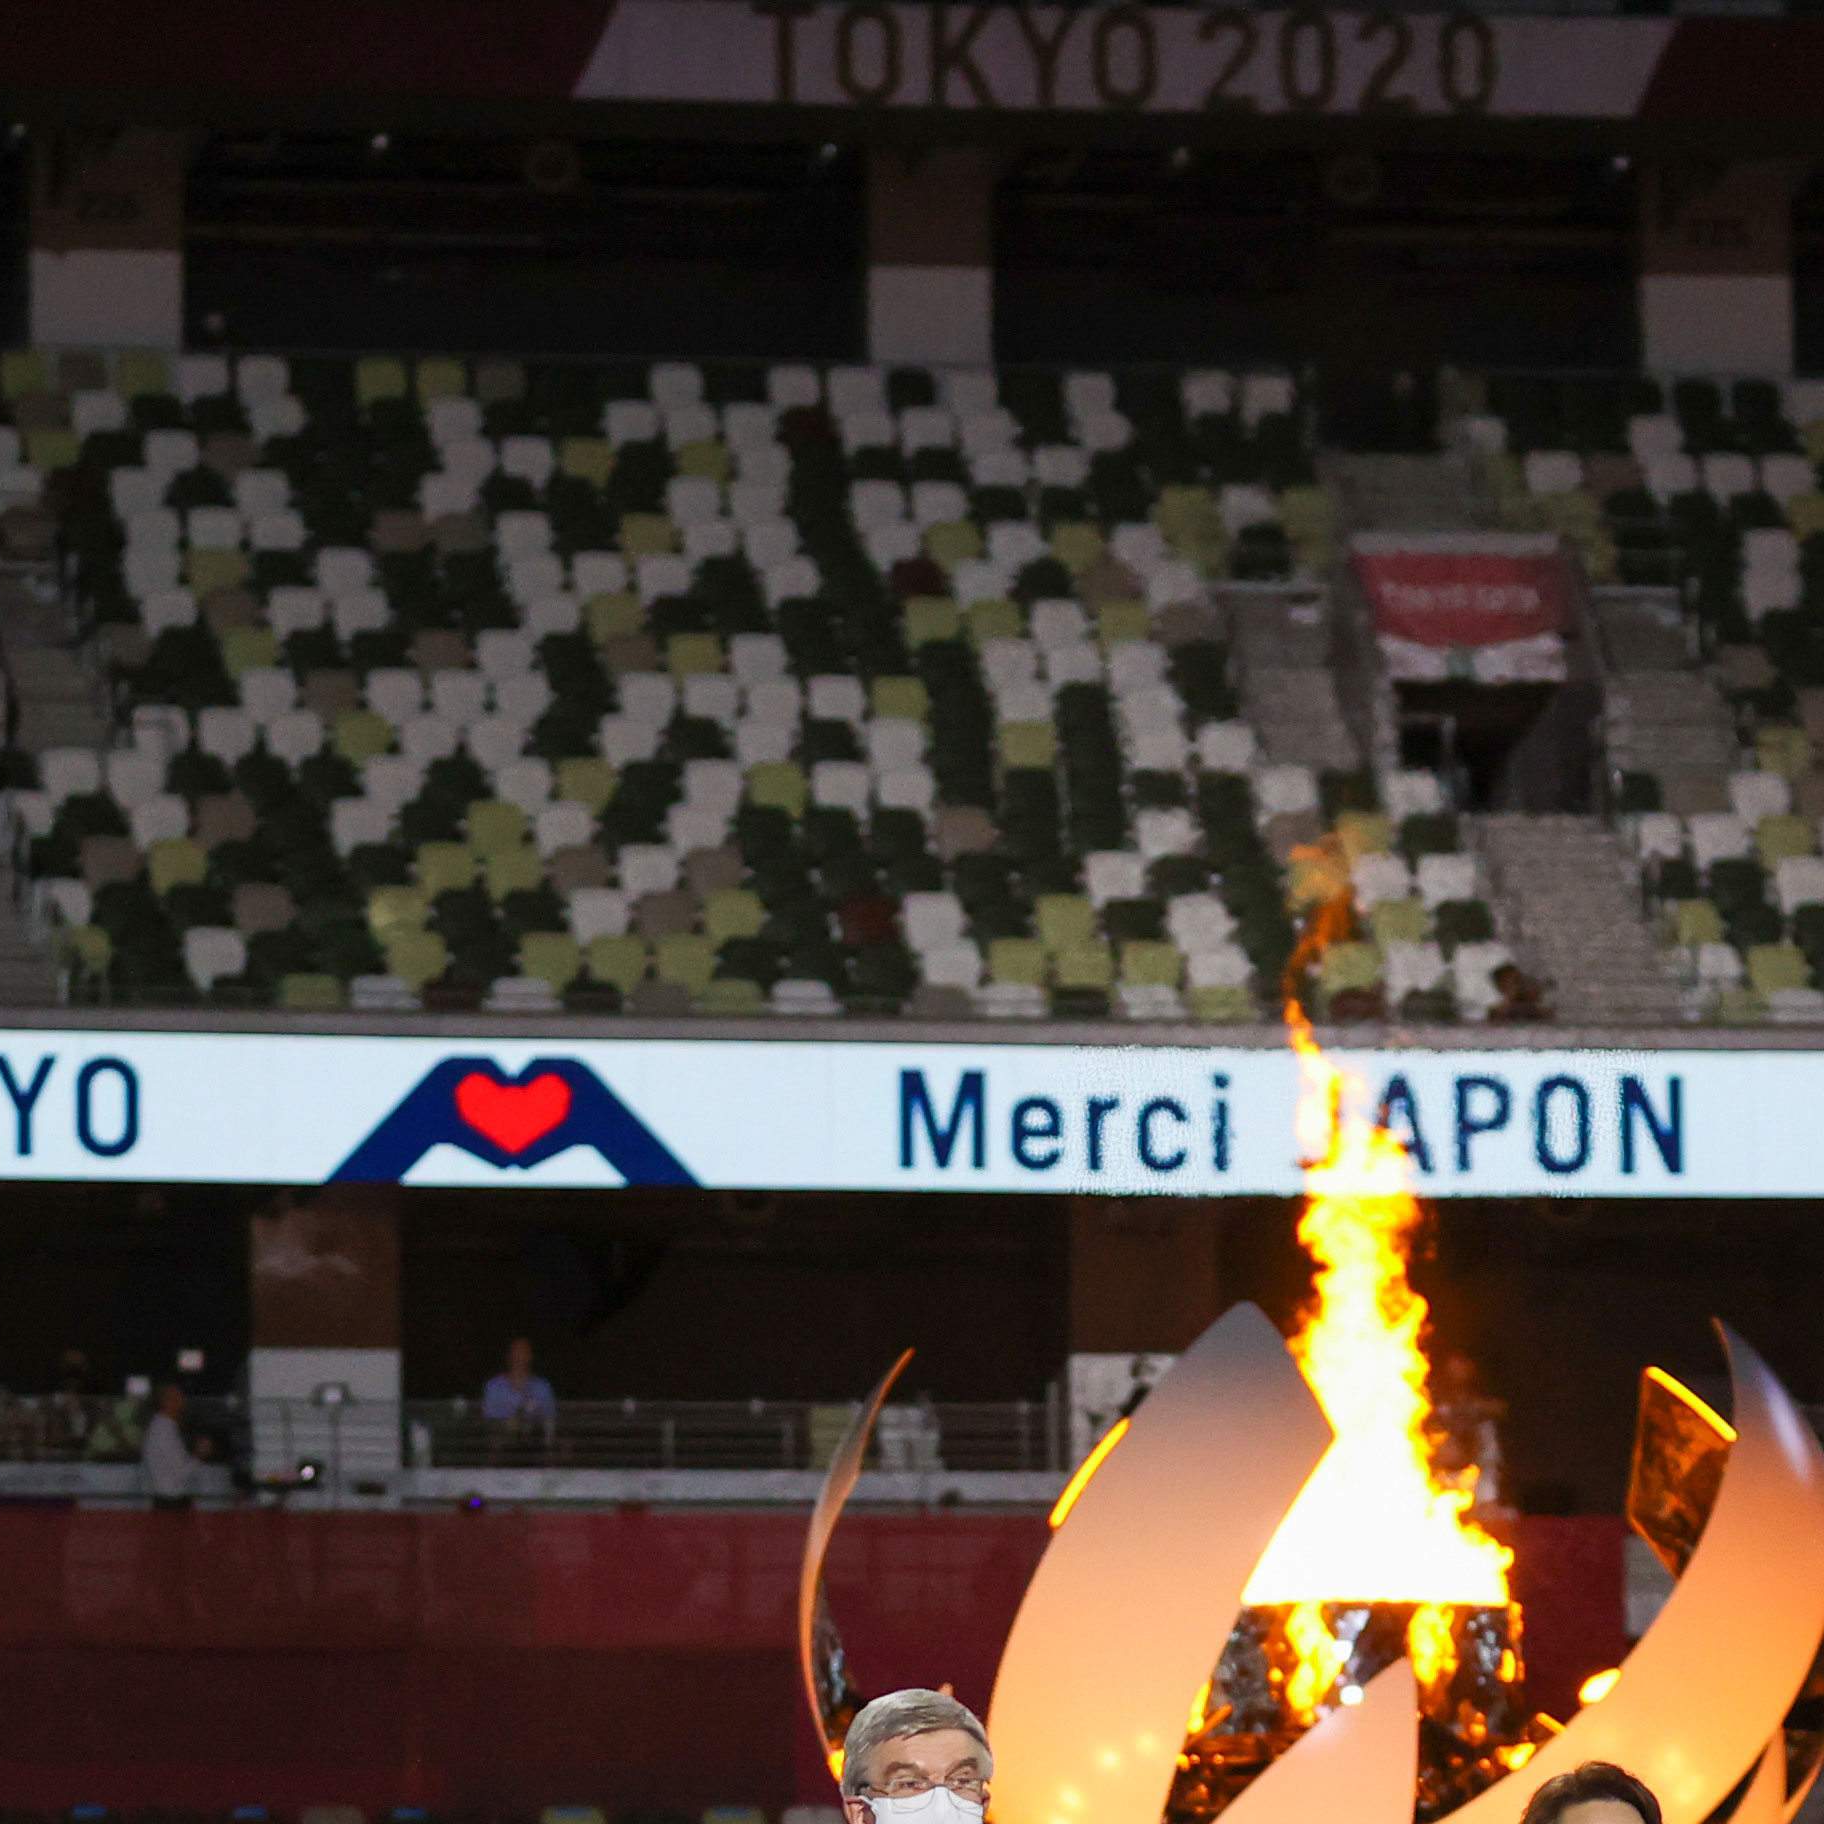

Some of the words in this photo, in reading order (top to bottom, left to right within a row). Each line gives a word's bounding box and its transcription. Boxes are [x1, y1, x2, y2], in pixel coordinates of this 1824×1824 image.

[751, 4, 1155, 109] TOKYO
[1196, 9, 1498, 115] 2020
[900, 1069, 1230, 1173] Merci
